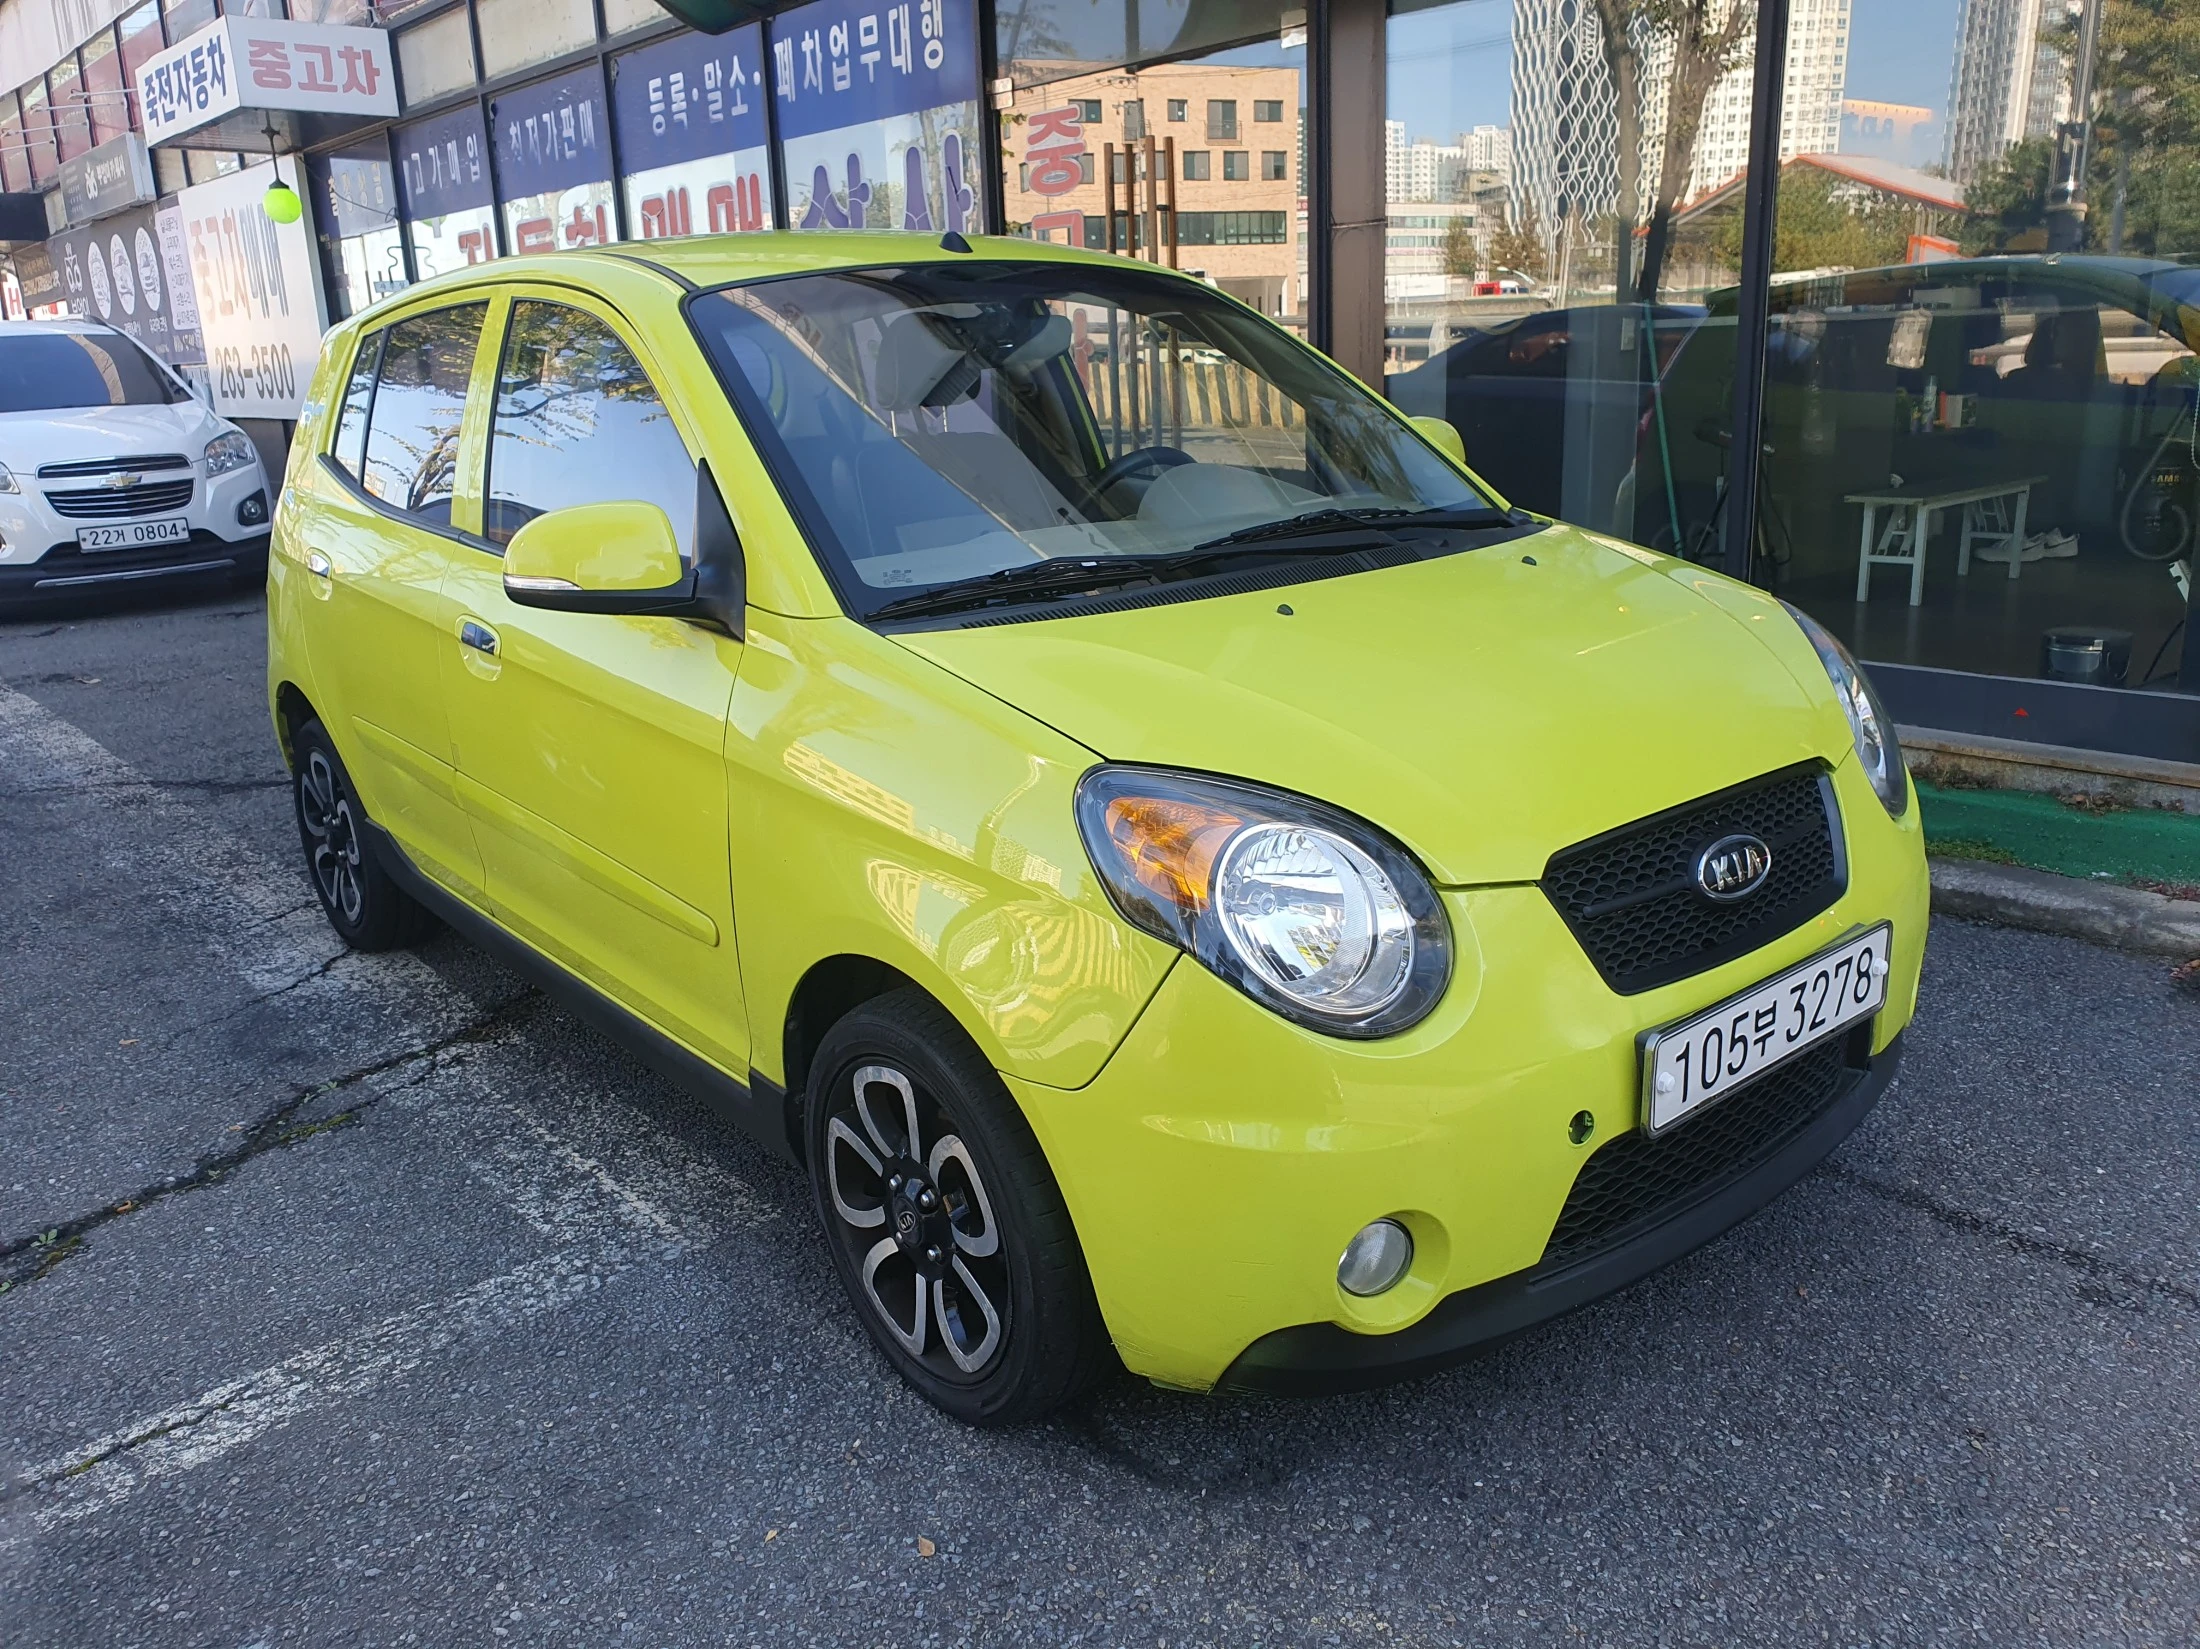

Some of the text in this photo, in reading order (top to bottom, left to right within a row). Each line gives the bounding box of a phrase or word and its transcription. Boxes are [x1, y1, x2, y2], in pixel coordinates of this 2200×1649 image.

[144, 33, 227, 128] 죽전자동차
[248, 38, 381, 96] 중고차
[774, 0, 944, 103] 폐차업무대행
[411, 133, 481, 195] 고가매입
[215, 342, 296, 400] 263-3500
[89, 522, 180, 546] 22거 0804
[1709, 845, 1764, 892] KIA
[1674, 945, 1874, 1103] 105부 3278
